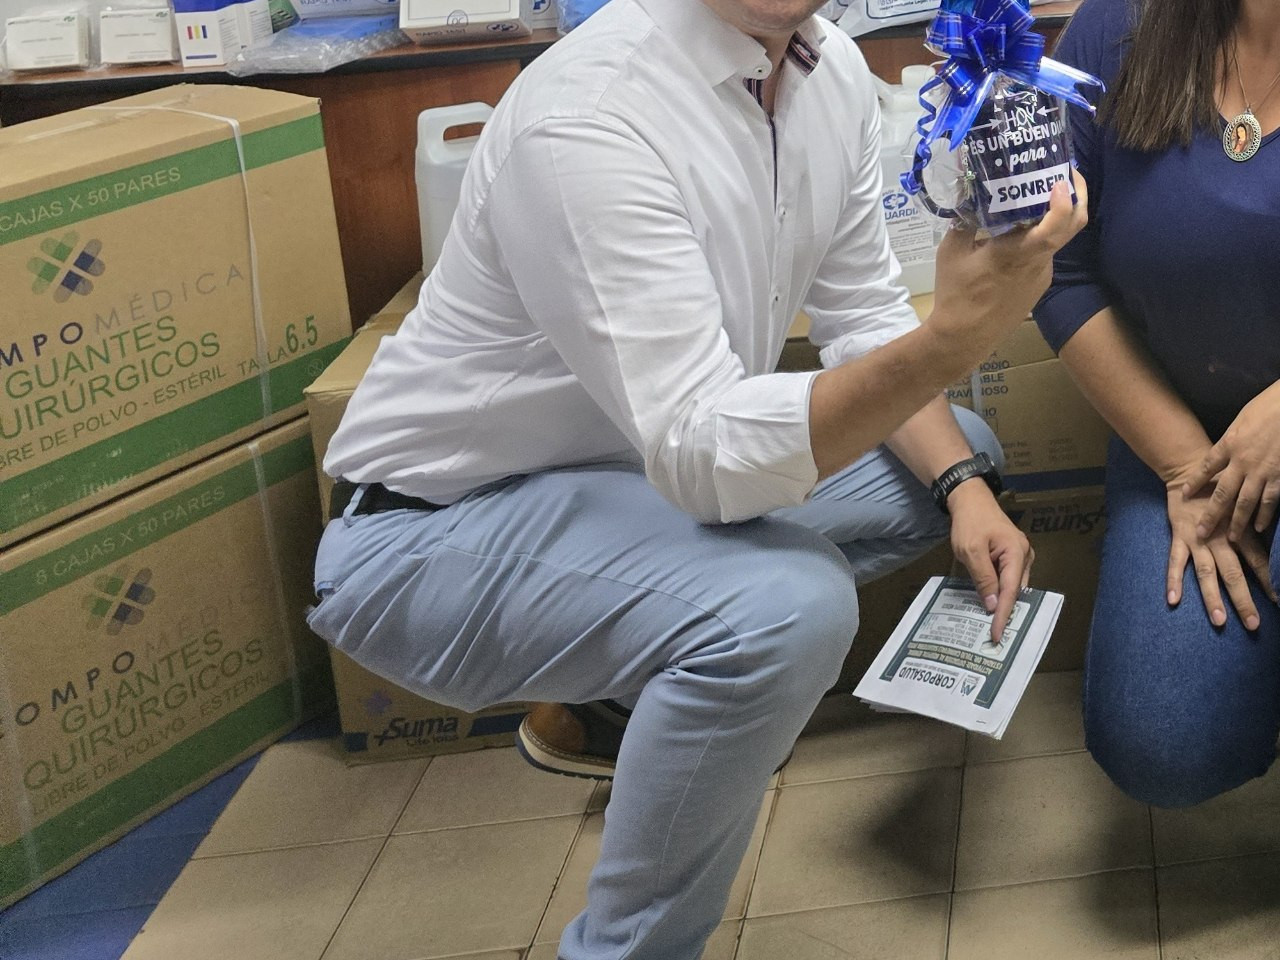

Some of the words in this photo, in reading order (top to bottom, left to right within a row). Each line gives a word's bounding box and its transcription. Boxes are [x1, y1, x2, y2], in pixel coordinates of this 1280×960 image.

[970, 140, 985, 155] ES
[988, 135, 1009, 151] UN
[1013, 124, 1050, 146] BUEN
[1004, 106, 1035, 131] HOY
[1010, 146, 1047, 172] para
[88, 187, 110, 207] 50
[114, 167, 182, 200] PARES
[885, 207, 920, 220] UARDI
[6, 315, 178, 400] GUANTES
[238, 346, 287, 376] TALA
[286, 315, 318, 353] 6.5
[41, 426, 69, 453] DE
[73, 401, 138, 435] POLVO
[153, 365, 227, 402] ESTÉRIL
[53, 539, 115, 577] CAJAS
[138, 518, 159, 539] 50
[163, 487, 226, 526] PARES
[61, 630, 223, 733] GUANTES
[899, 667, 955, 688] CORPOSALUD
[93, 755, 120, 779] DE
[124, 716, 186, 759] POLVO
